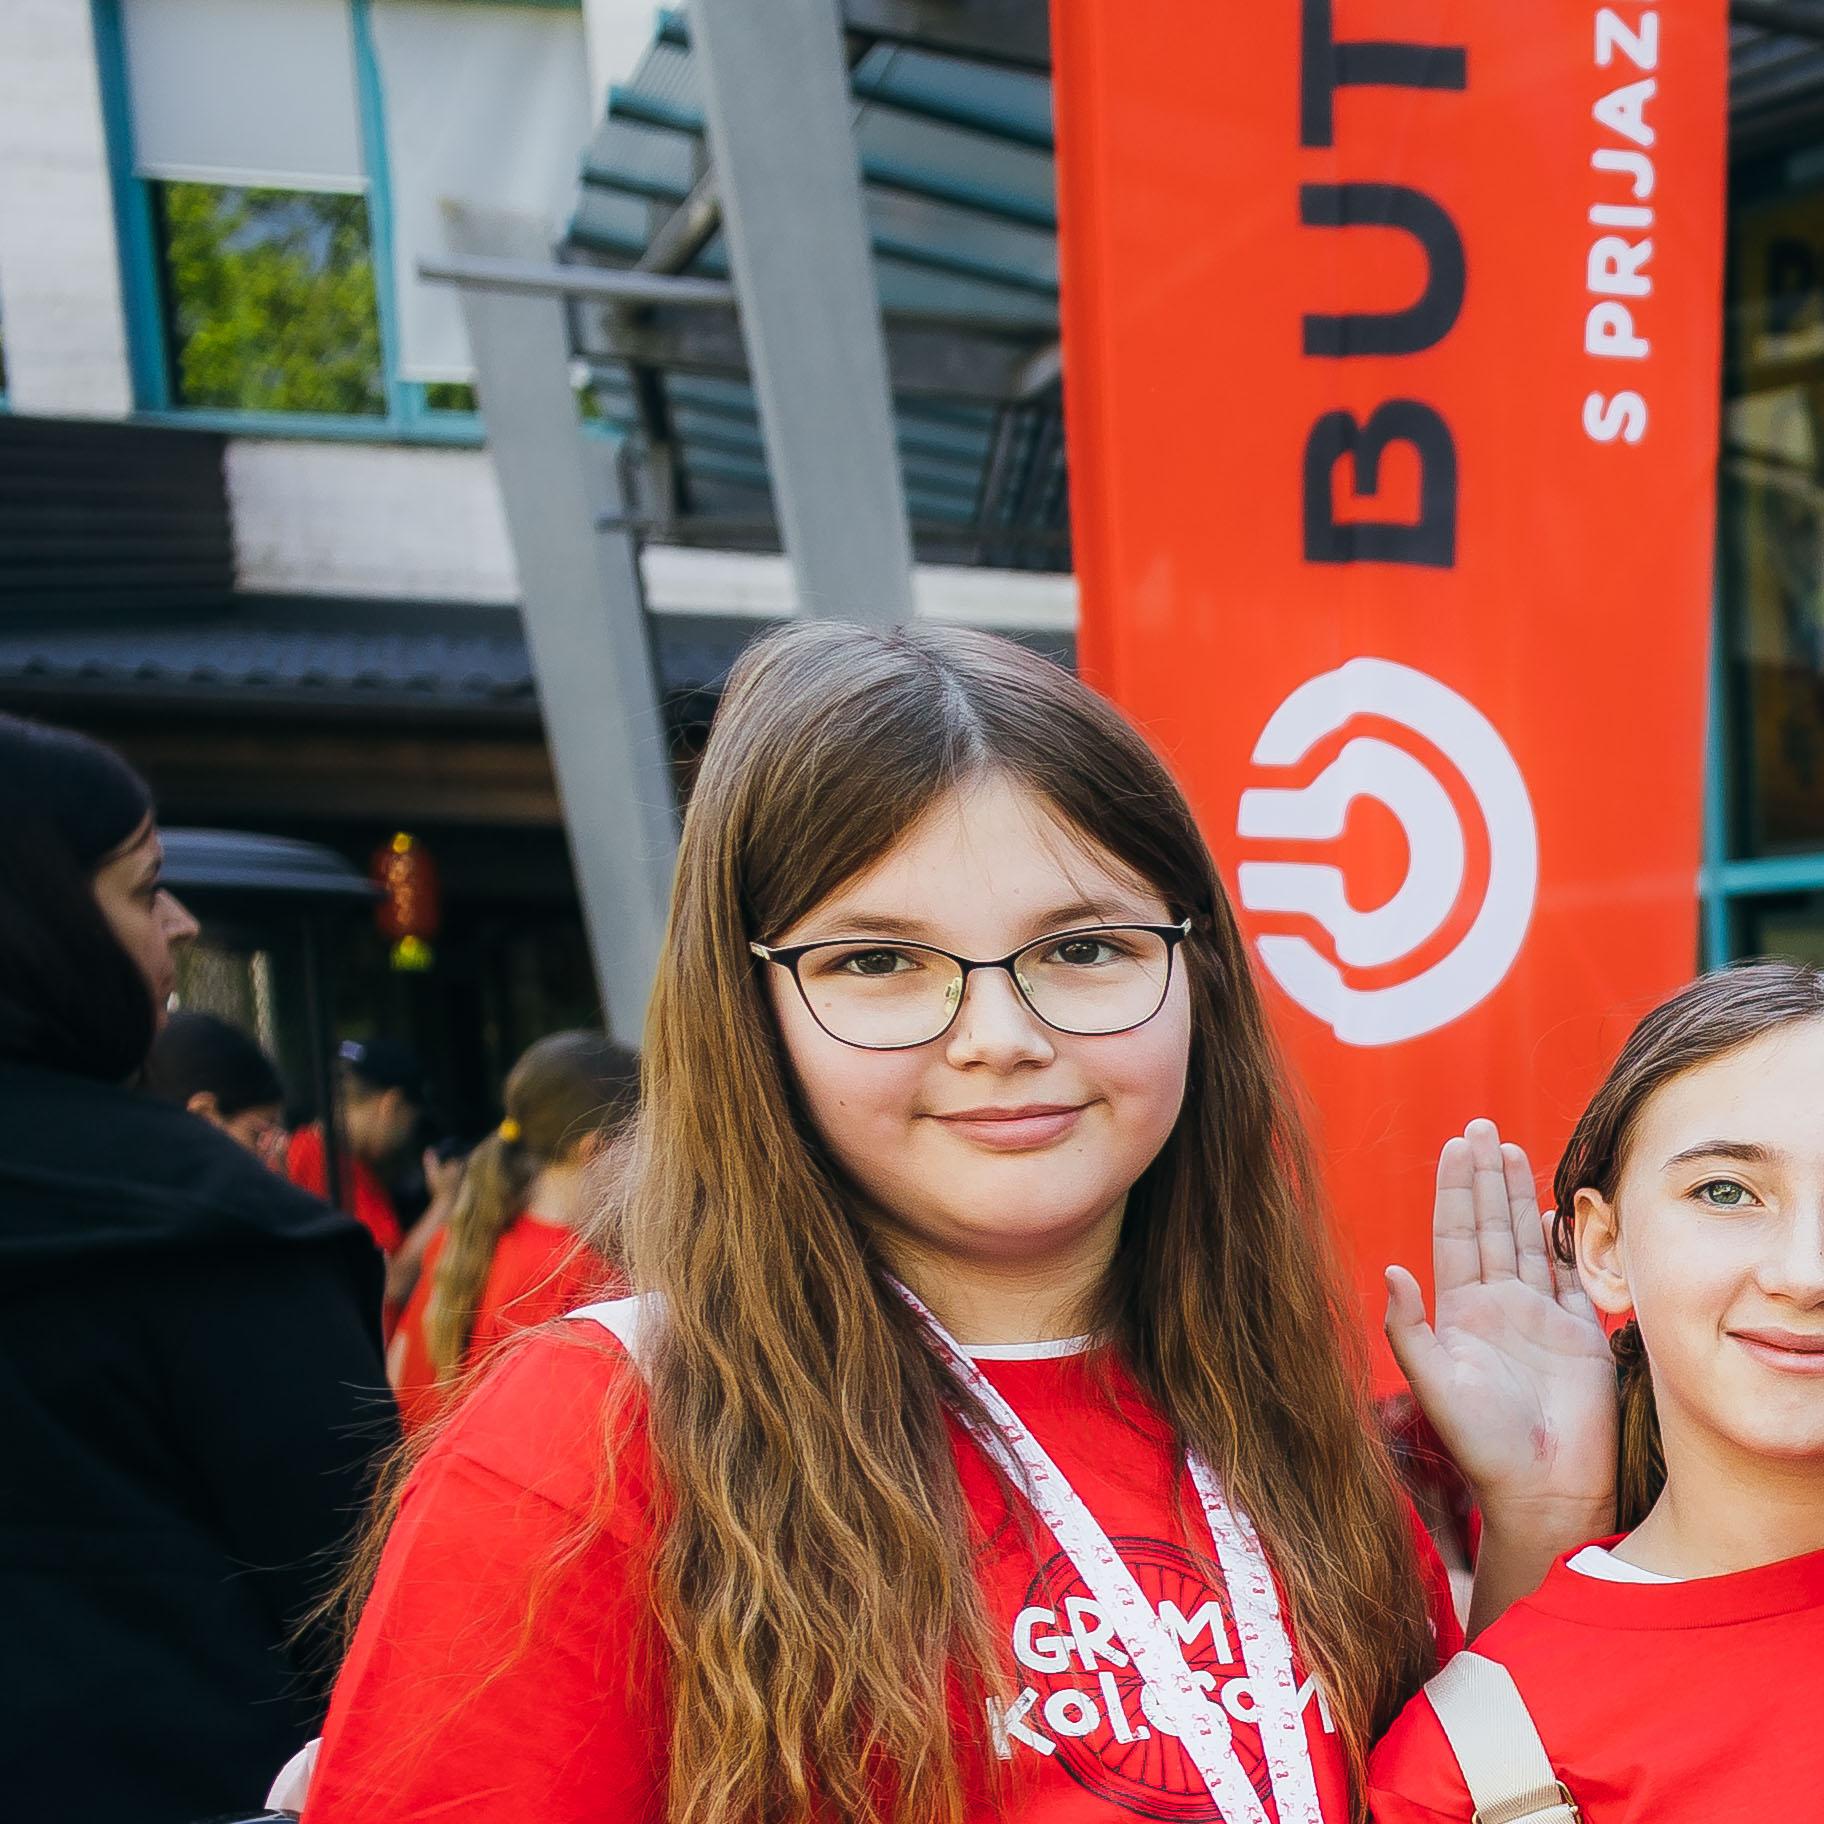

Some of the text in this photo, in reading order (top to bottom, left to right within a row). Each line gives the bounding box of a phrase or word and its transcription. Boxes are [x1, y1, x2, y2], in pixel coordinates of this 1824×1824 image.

[1582, 0, 1660, 444] S PRIJAZ
[1012, 1595, 1236, 1674] GRM
